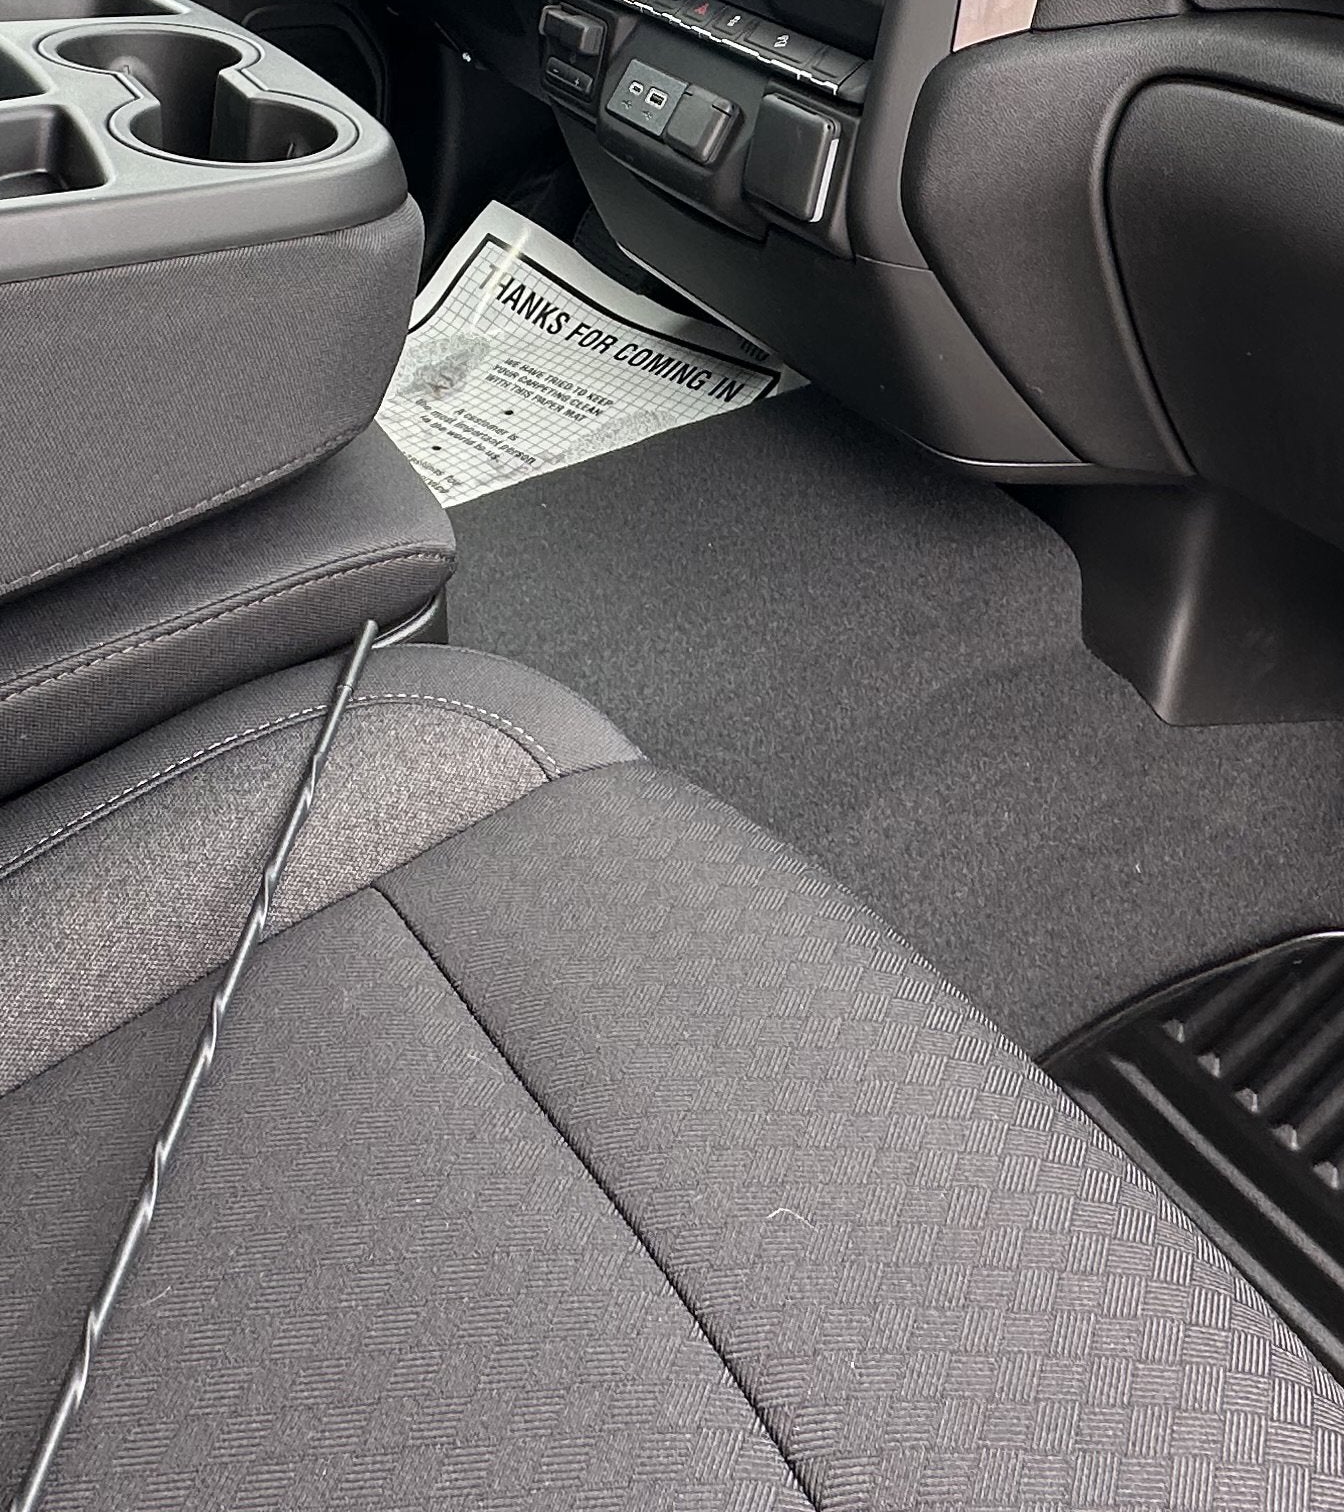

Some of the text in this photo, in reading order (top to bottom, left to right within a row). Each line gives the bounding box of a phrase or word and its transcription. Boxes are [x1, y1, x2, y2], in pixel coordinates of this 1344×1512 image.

[479, 264, 570, 335] THANKS
[564, 322, 619, 354] FOR
[613, 343, 712, 391] COMING
[708, 377, 745, 403] IN
[485, 373, 587, 422] WITH THIS PAPER MAT
[492, 364, 603, 416] YOUR CARPETING CLEAN
[519, 364, 545, 378] HAVE
[544, 374, 574, 390] TRIED
[572, 386, 587, 396] TO
[586, 392, 613, 406] KEEP
[464, 413, 509, 435] customer
[498, 444, 536, 465] person
